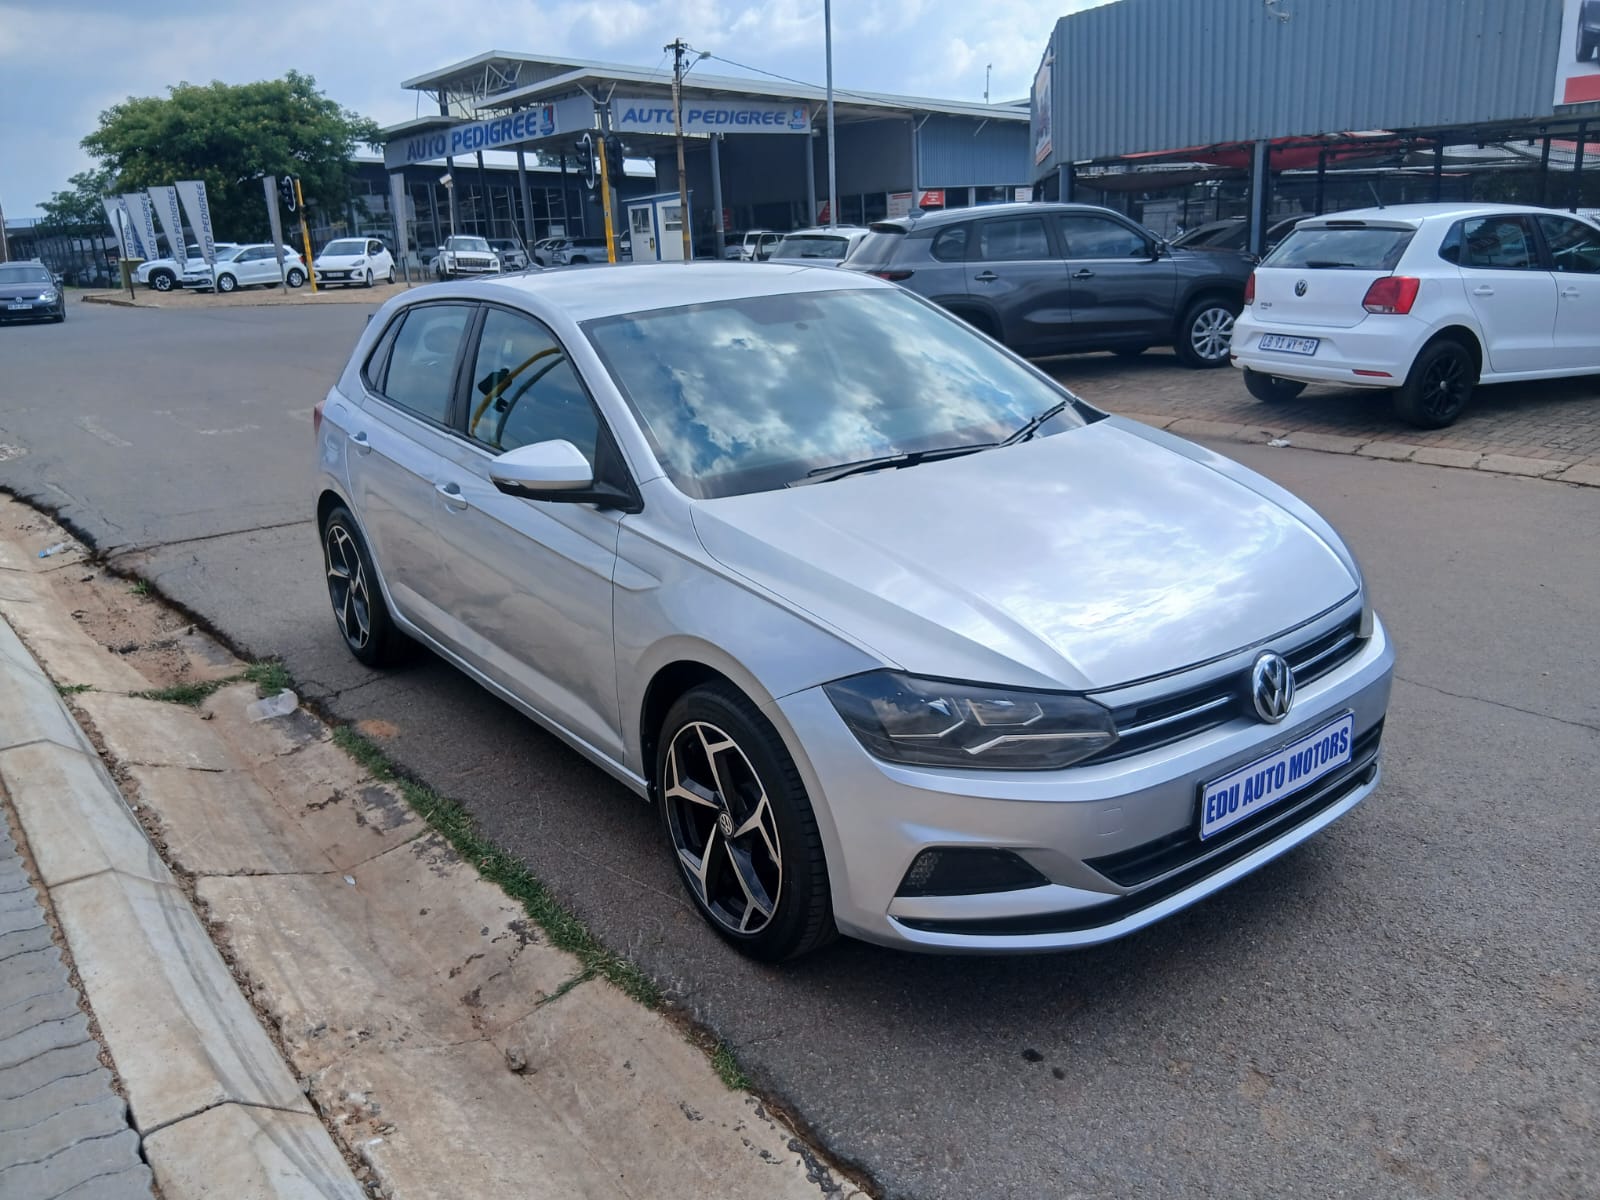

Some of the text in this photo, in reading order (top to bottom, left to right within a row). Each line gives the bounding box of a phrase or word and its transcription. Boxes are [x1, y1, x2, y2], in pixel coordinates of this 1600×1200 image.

[407, 112, 536, 161] AUTO PEDIGREE
[687, 109, 786, 125] PEDIGREE
[140, 195, 154, 238] PEDIGREE
[167, 187, 181, 233] PEDIGREE
[196, 183, 215, 261] AUTO PEDIGREE
[1206, 727, 1349, 824] EDU AUTO MOTORS
